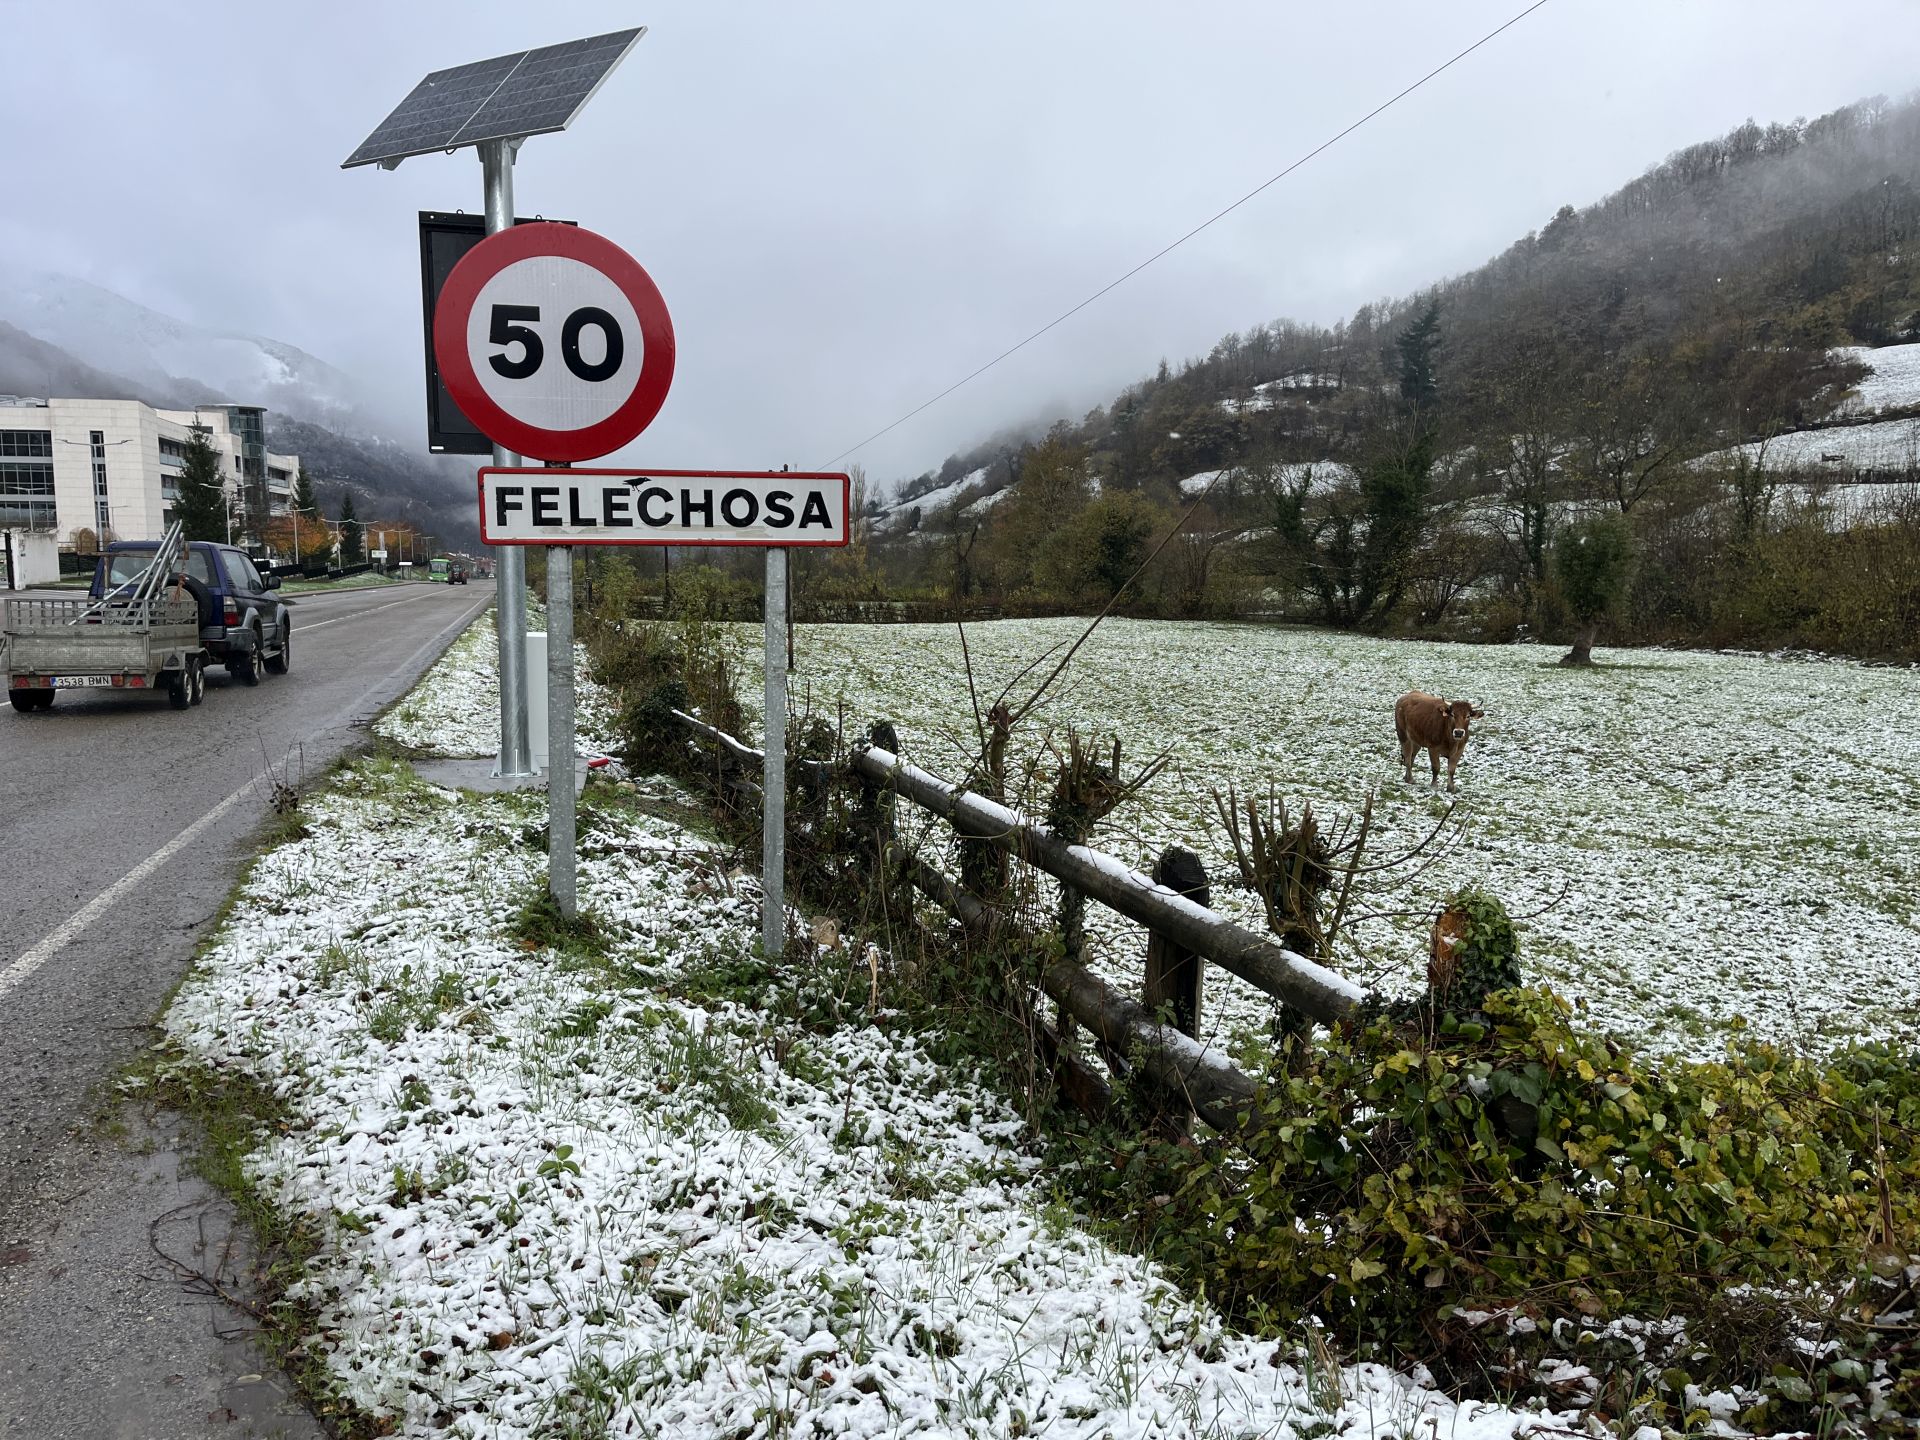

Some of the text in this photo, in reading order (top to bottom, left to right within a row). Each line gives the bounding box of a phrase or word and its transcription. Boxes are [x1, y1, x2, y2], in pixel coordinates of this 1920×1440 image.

[488, 303, 624, 383] 50
[495, 485, 834, 529] FELECHOSA
[58, 676, 110, 687] 3538 BMN
